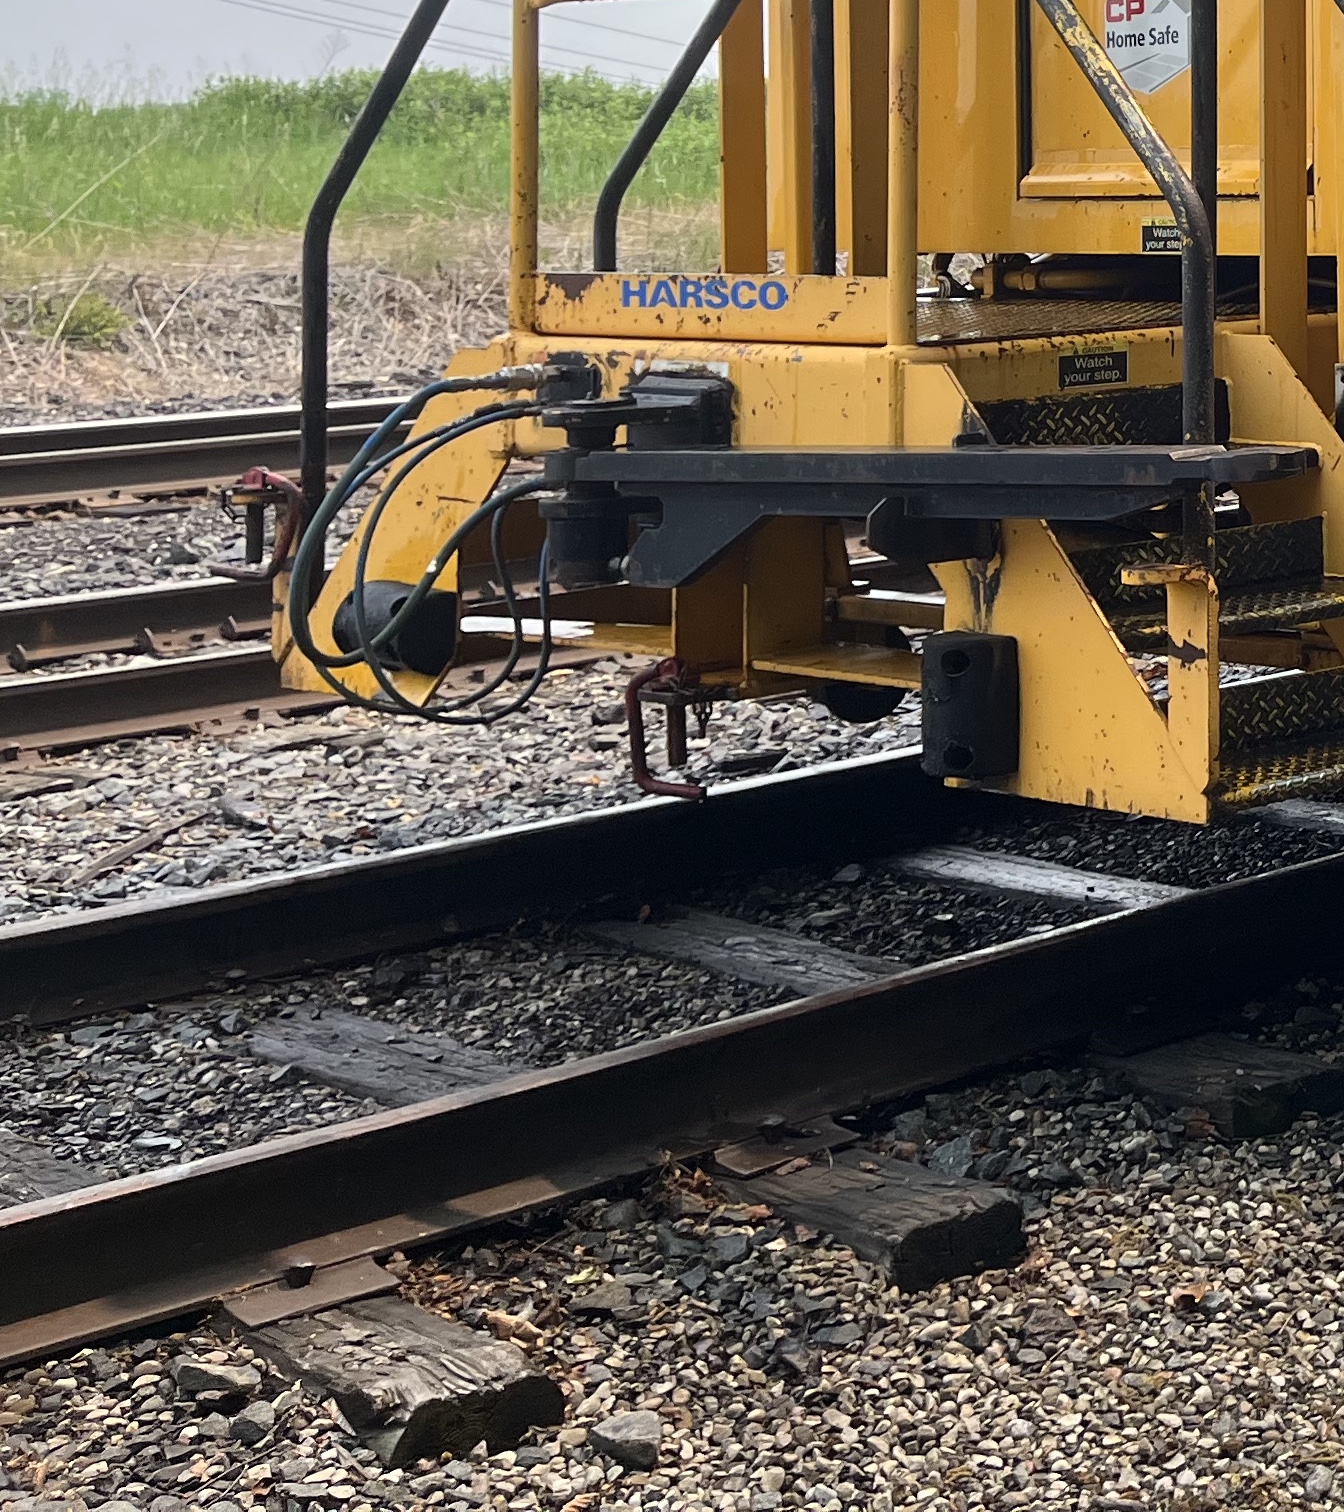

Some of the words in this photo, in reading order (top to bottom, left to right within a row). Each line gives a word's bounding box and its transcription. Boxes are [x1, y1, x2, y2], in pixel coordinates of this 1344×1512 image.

[1106, 30, 1145, 49] Home
[1149, 26, 1179, 46] Safe
[1152, 227, 1181, 238] Watch
[1145, 240, 1165, 251] your
[621, 279, 789, 310] HARSCO
[1074, 355, 1113, 369] Watch
[1064, 372, 1092, 385] your
[1094, 369, 1122, 381] step.
